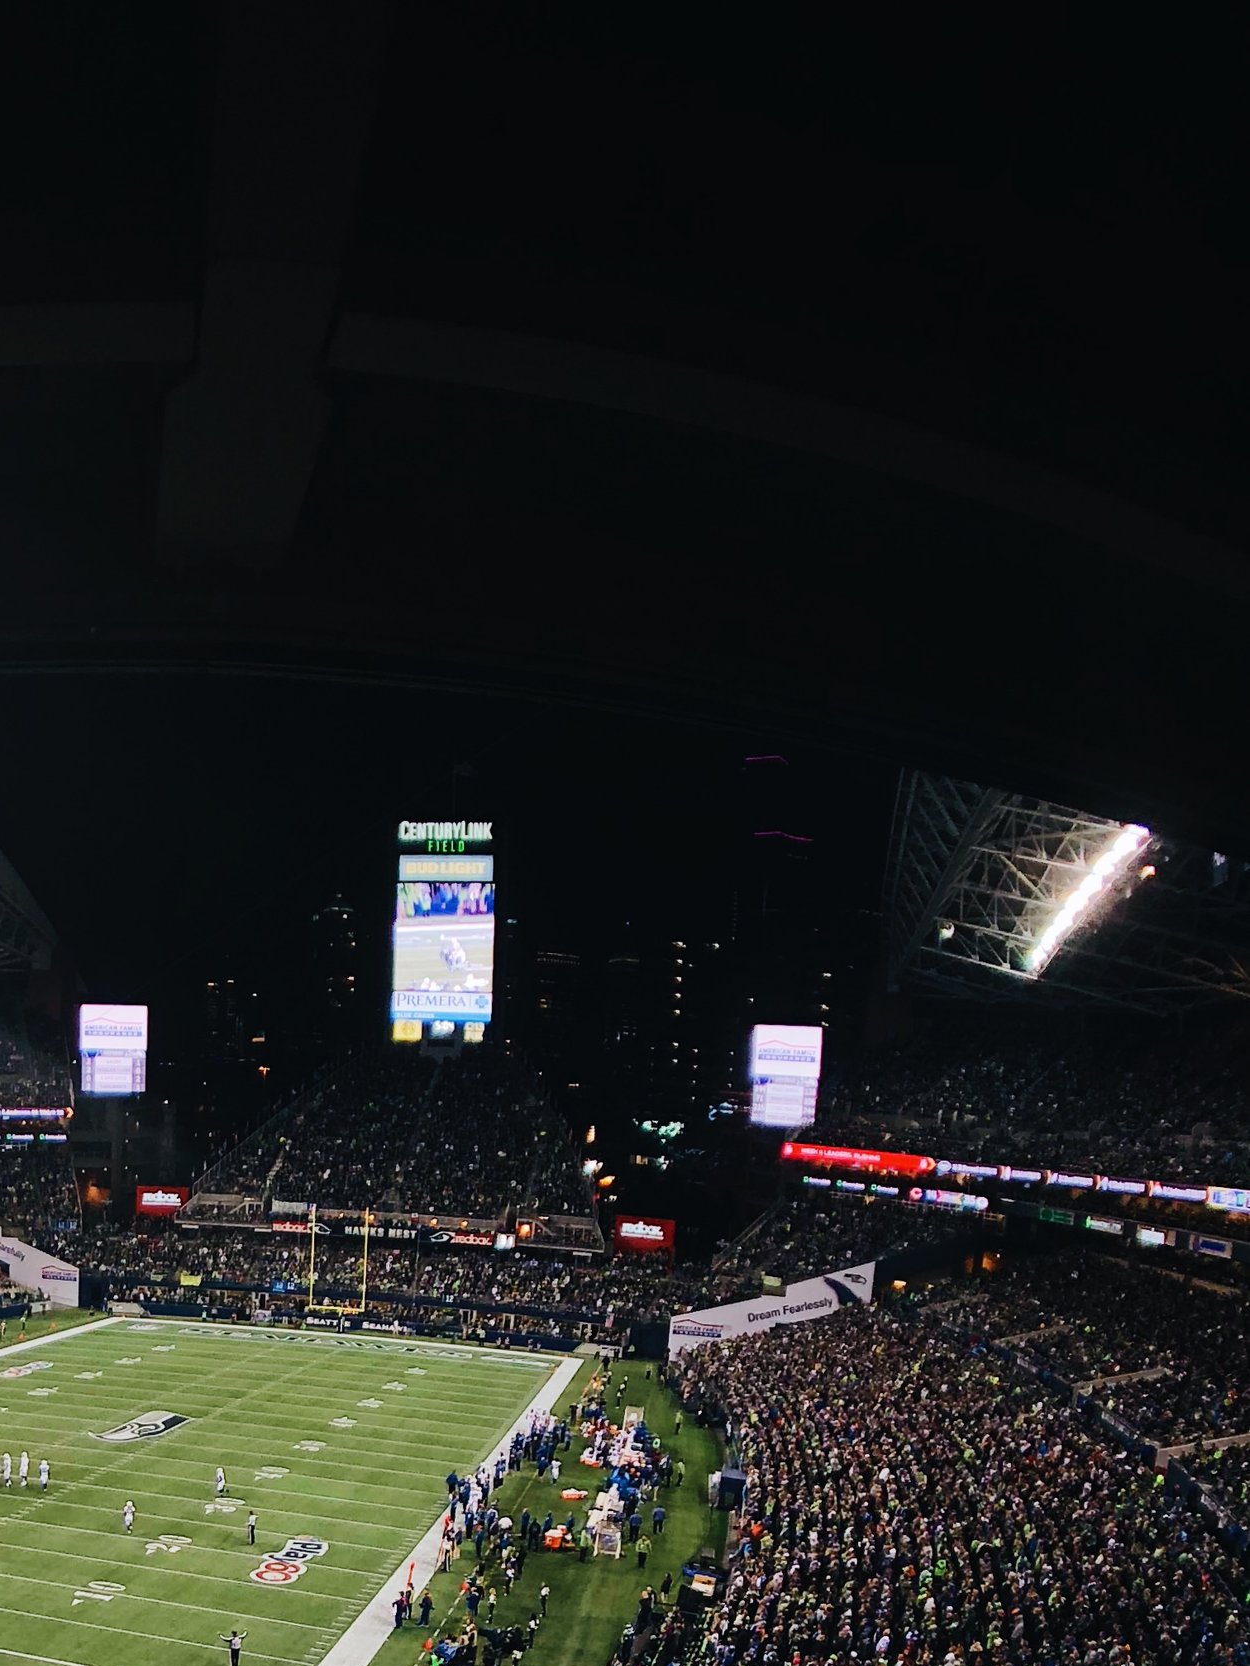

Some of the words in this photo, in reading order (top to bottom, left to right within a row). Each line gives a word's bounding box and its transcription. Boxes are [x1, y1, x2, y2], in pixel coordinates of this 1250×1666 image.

[429, 841, 466, 853] FIELD
[405, 862, 440, 876] BUD
[441, 862, 487, 875] LIGHT
[397, 992, 468, 1008] PREMERA
[344, 1226, 384, 1238] HAWKS
[388, 1228, 417, 1239] NEST
[747, 1308, 781, 1323] Dream
[782, 1297, 834, 1317] Fearlessly
[306, 1316, 352, 1328] SEATTE
[73, 1580, 127, 1602] 10
